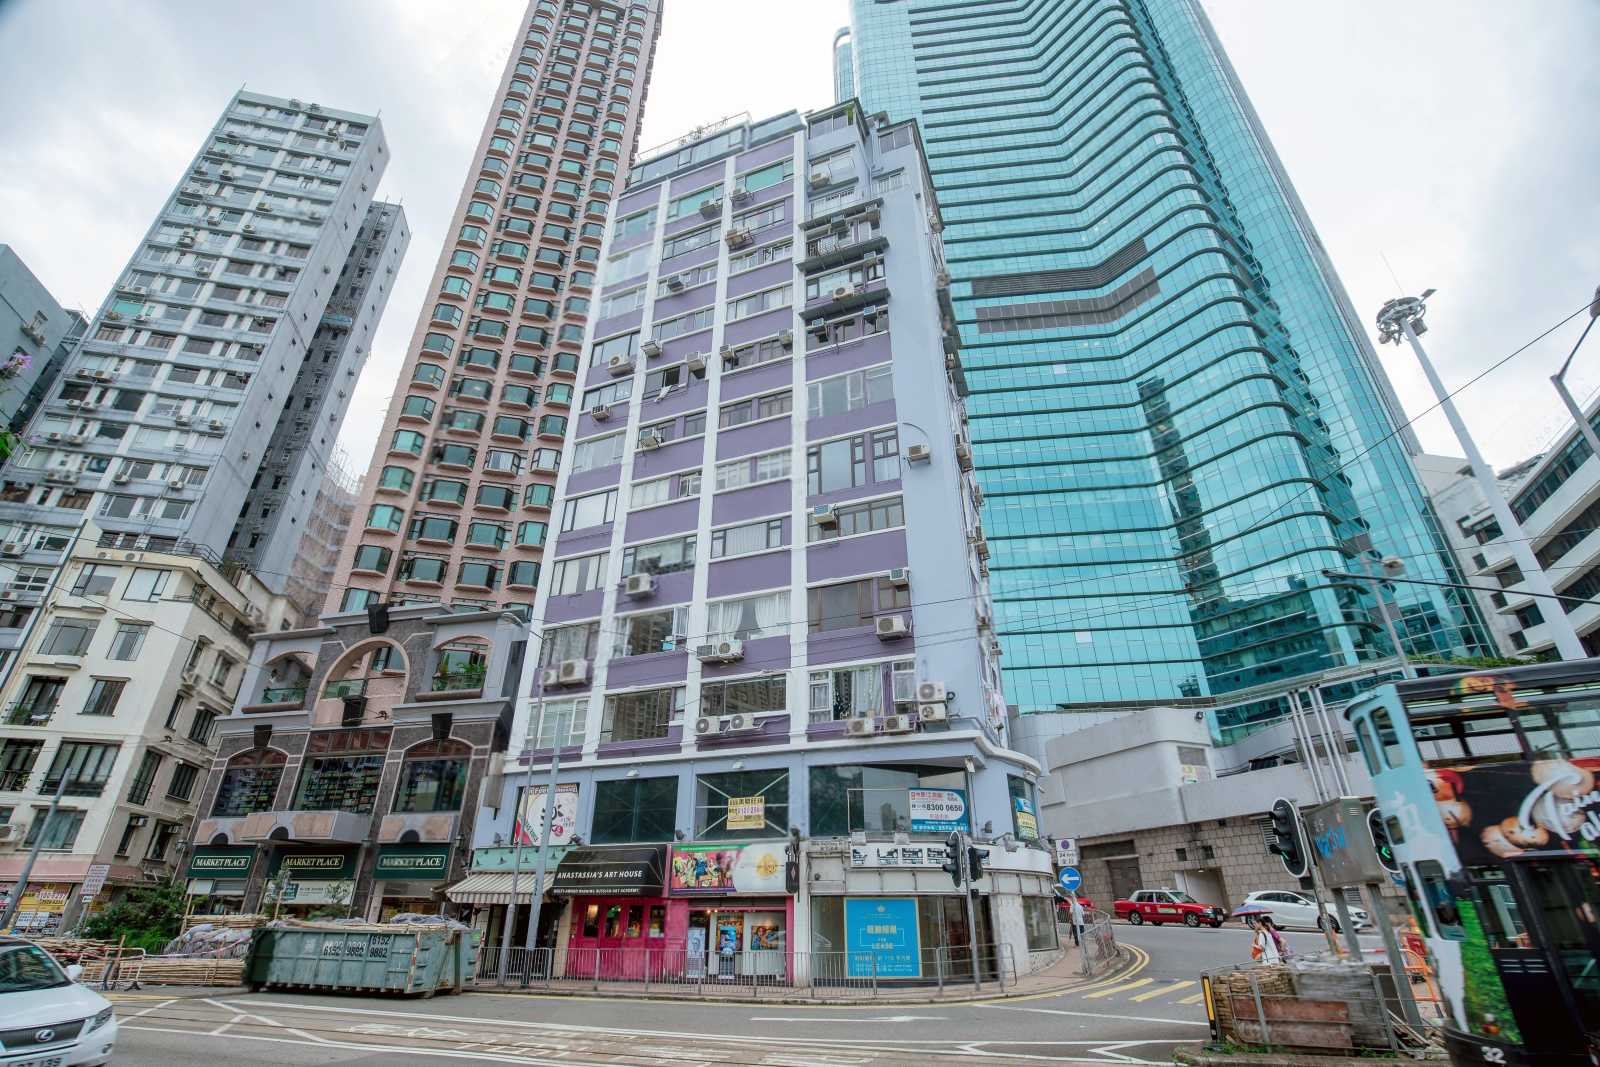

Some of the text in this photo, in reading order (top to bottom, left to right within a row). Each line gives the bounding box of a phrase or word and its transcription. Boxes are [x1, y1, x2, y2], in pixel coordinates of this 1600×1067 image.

[195, 858, 247, 867] MARKET PLACE
[286, 857, 340, 866] MARKET PLACE
[382, 857, 442, 867] MARKET PLACE
[556, 871, 603, 879] ANASTASSIA'S
[619, 870, 643, 878] HOUSE
